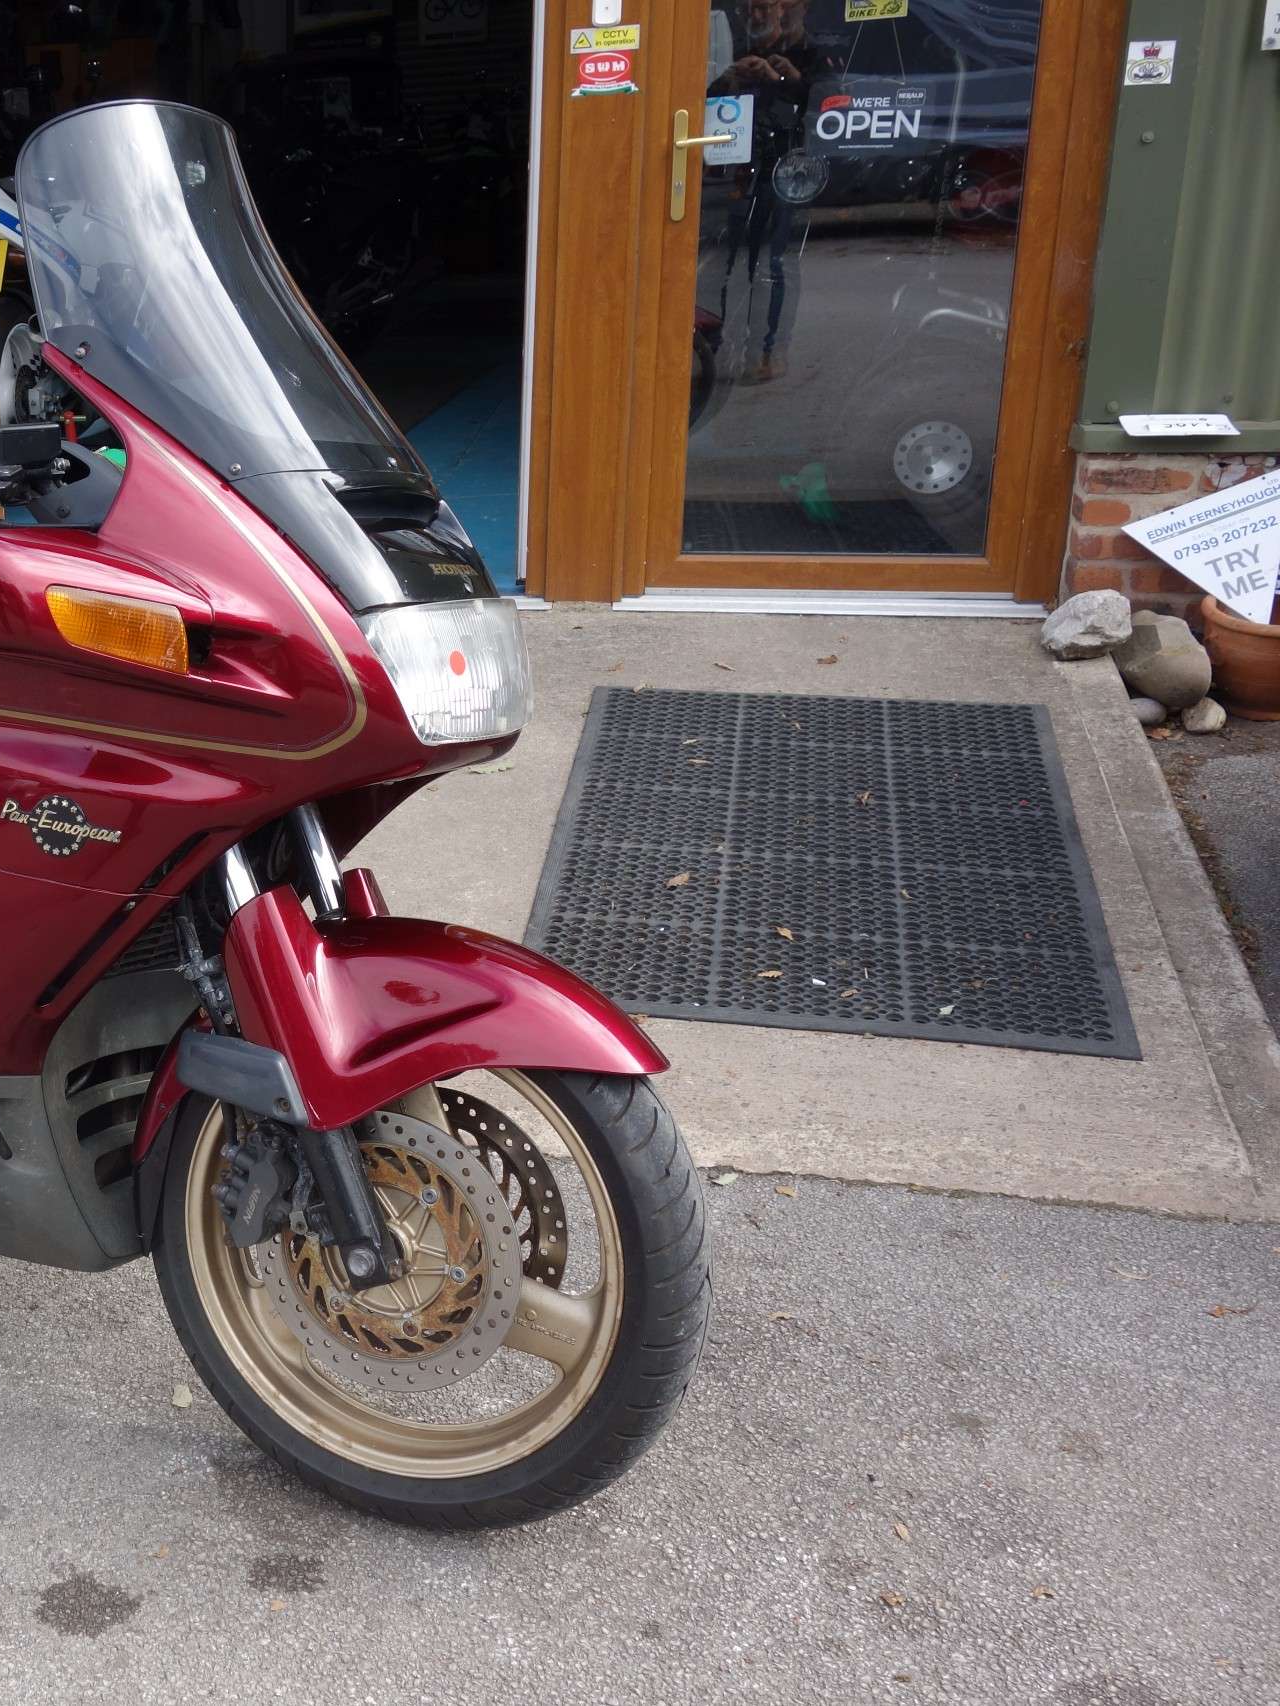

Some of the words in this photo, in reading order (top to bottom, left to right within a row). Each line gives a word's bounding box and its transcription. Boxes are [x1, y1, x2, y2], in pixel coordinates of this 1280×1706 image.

[602, 30, 629, 39] CCTV
[603, 38, 636, 46] operation
[852, 96, 891, 108] WE'RE
[816, 109, 921, 140] OPEN
[1146, 519, 1187, 540] EDWIN
[1189, 483, 1280, 524] FERNEYHOUGH
[1173, 536, 1220, 560] 07939
[1221, 515, 1279, 543] 207232
[1204, 543, 1261, 578] TRY
[1221, 569, 1270, 600] ME
[0, 799, 122, 842] Pan-European
